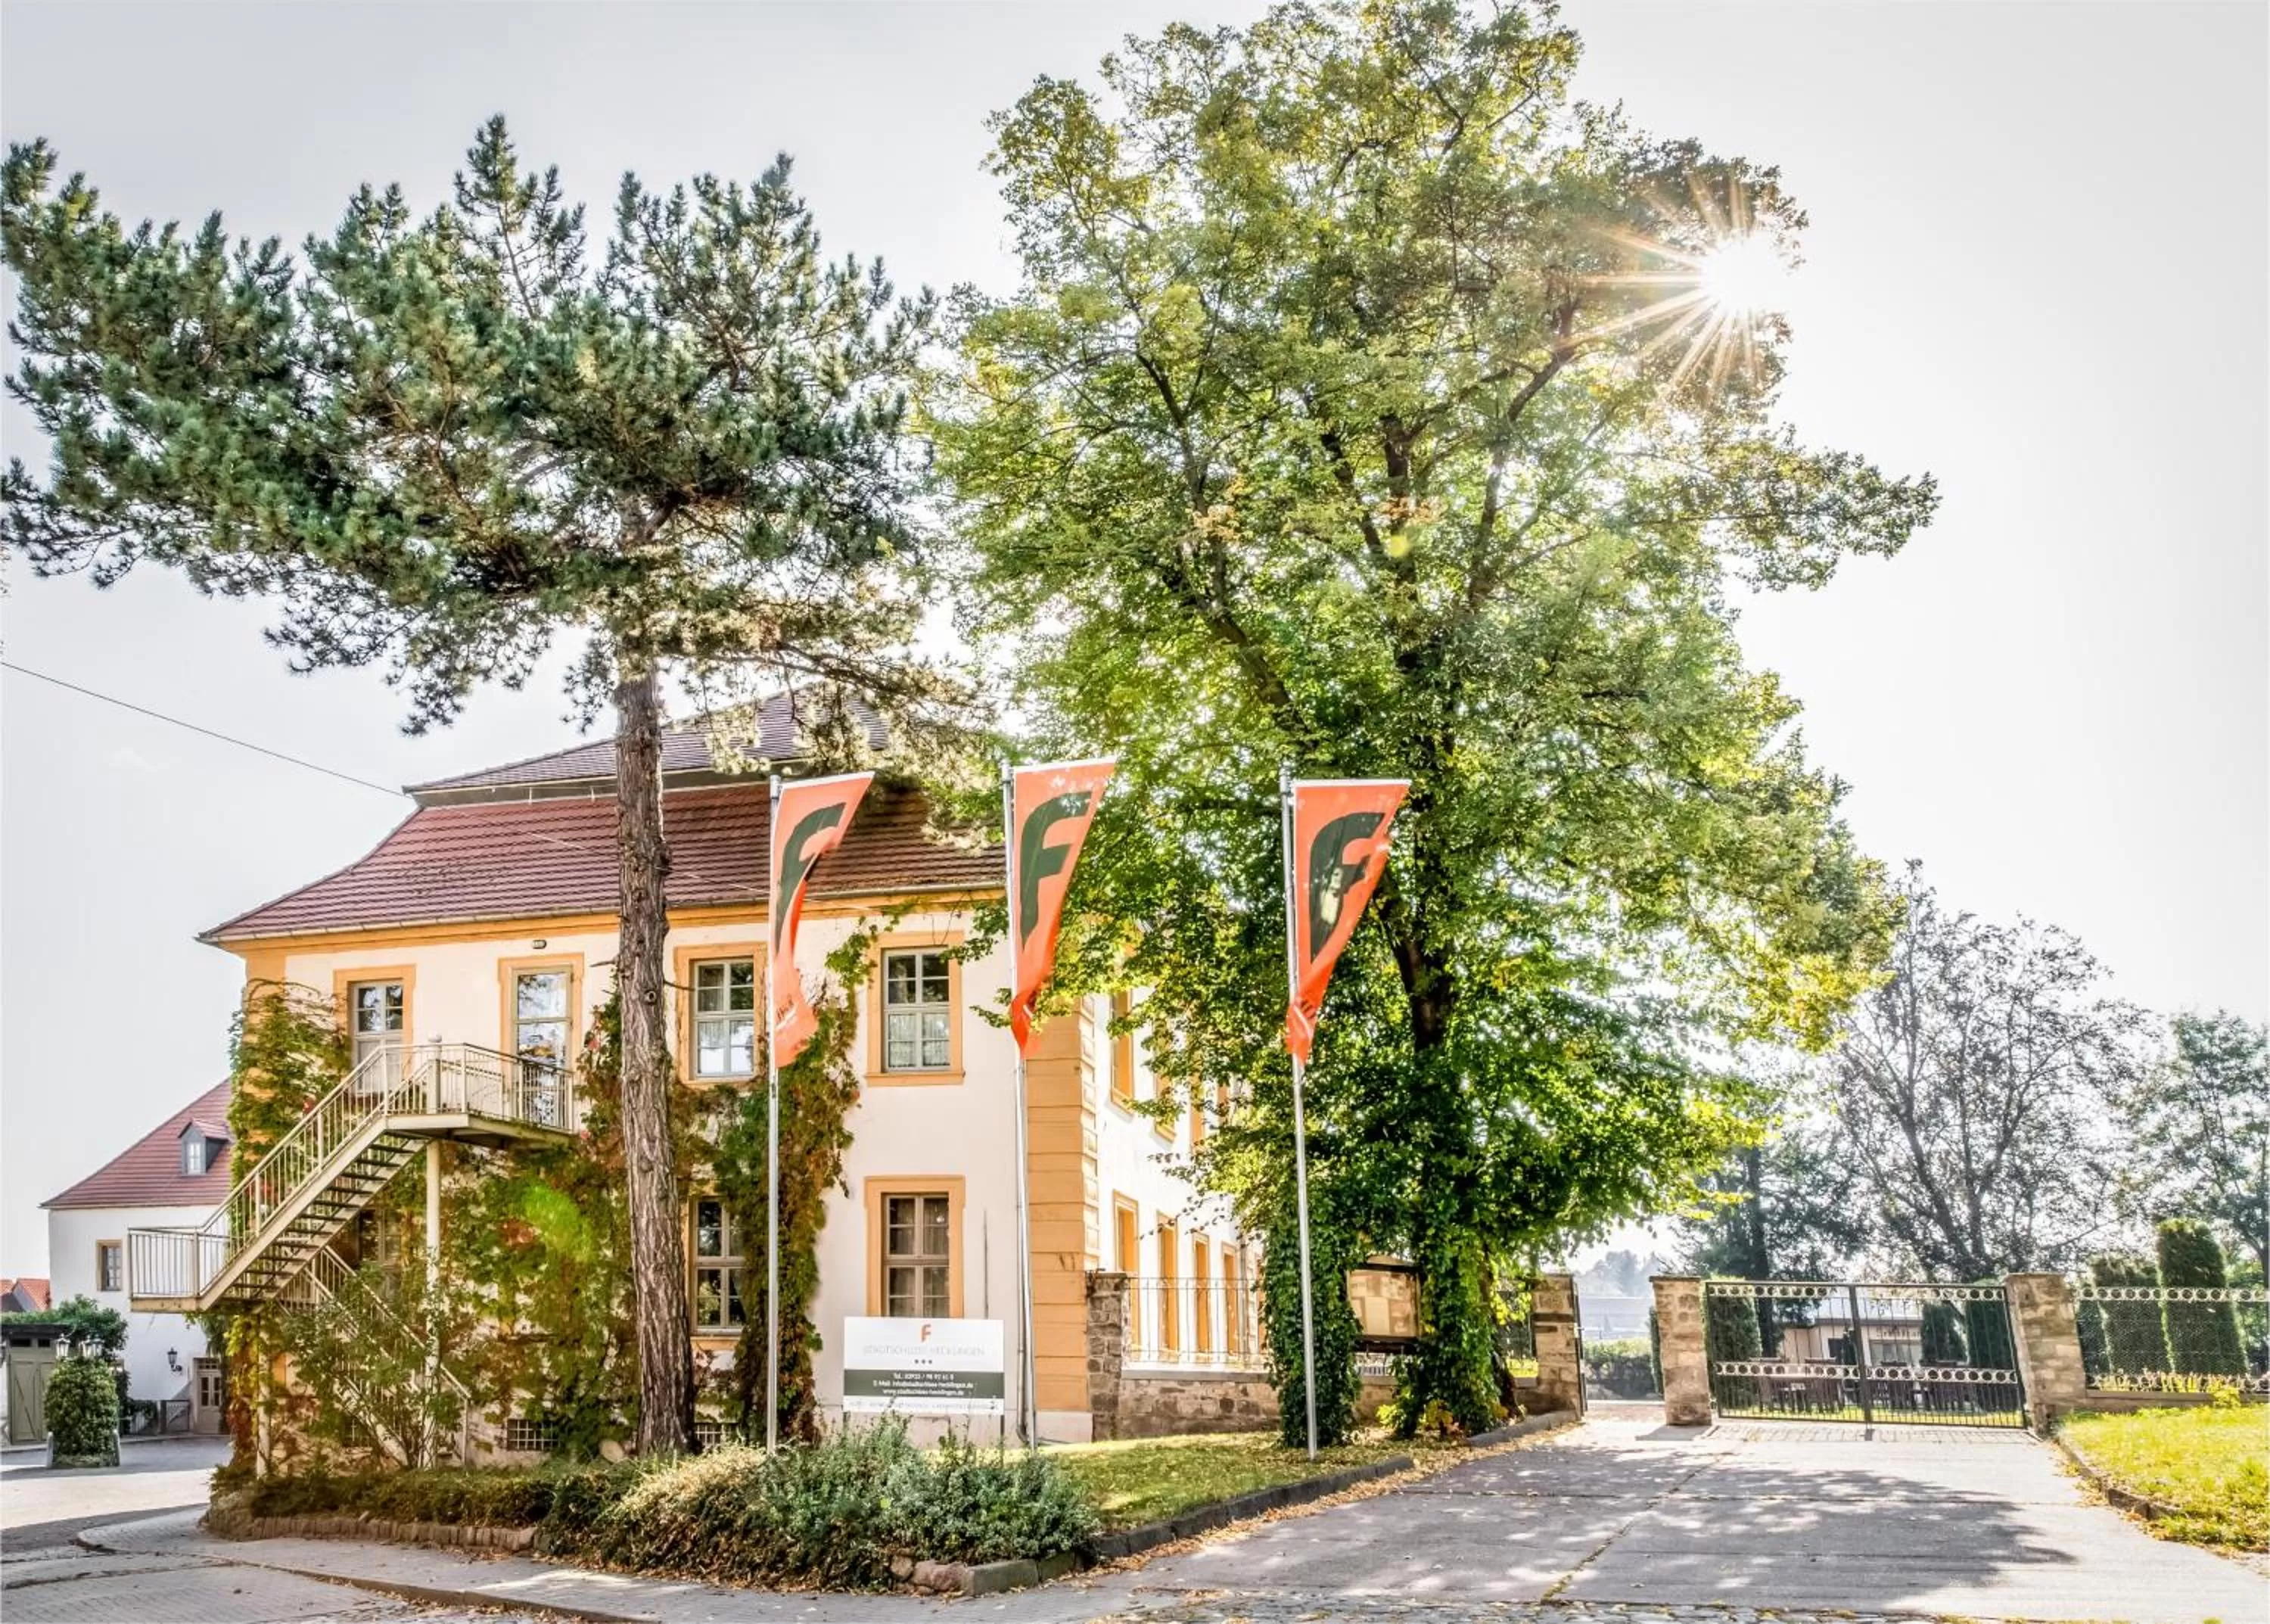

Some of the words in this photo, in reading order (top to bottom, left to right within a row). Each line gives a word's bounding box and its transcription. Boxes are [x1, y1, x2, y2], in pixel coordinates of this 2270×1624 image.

[1020, 791, 1092, 953] F
[1310, 812, 1385, 964] F
[921, 1324, 931, 1342] F
